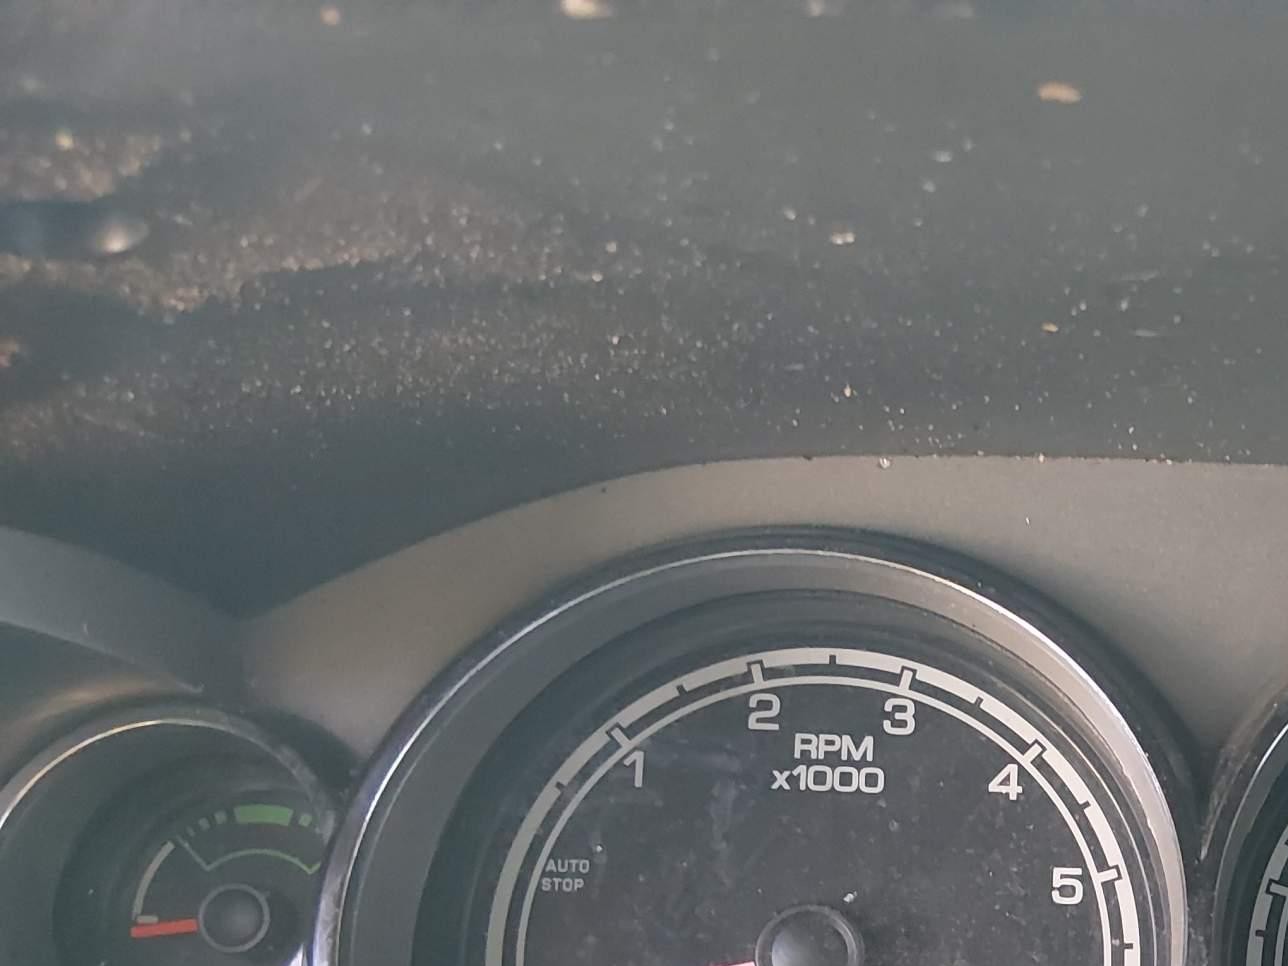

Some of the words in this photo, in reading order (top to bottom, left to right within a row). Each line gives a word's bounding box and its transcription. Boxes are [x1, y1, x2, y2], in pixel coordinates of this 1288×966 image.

[747, 694, 781, 731] 2
[882, 699, 916, 736] 3
[793, 733, 874, 763] RPM
[624, 750, 645, 788] 1
[771, 765, 885, 794] x1000
[987, 764, 1023, 801] 4
[545, 858, 591, 874] AUTO
[541, 877, 585, 893] STOP
[1051, 867, 1083, 904] 5
